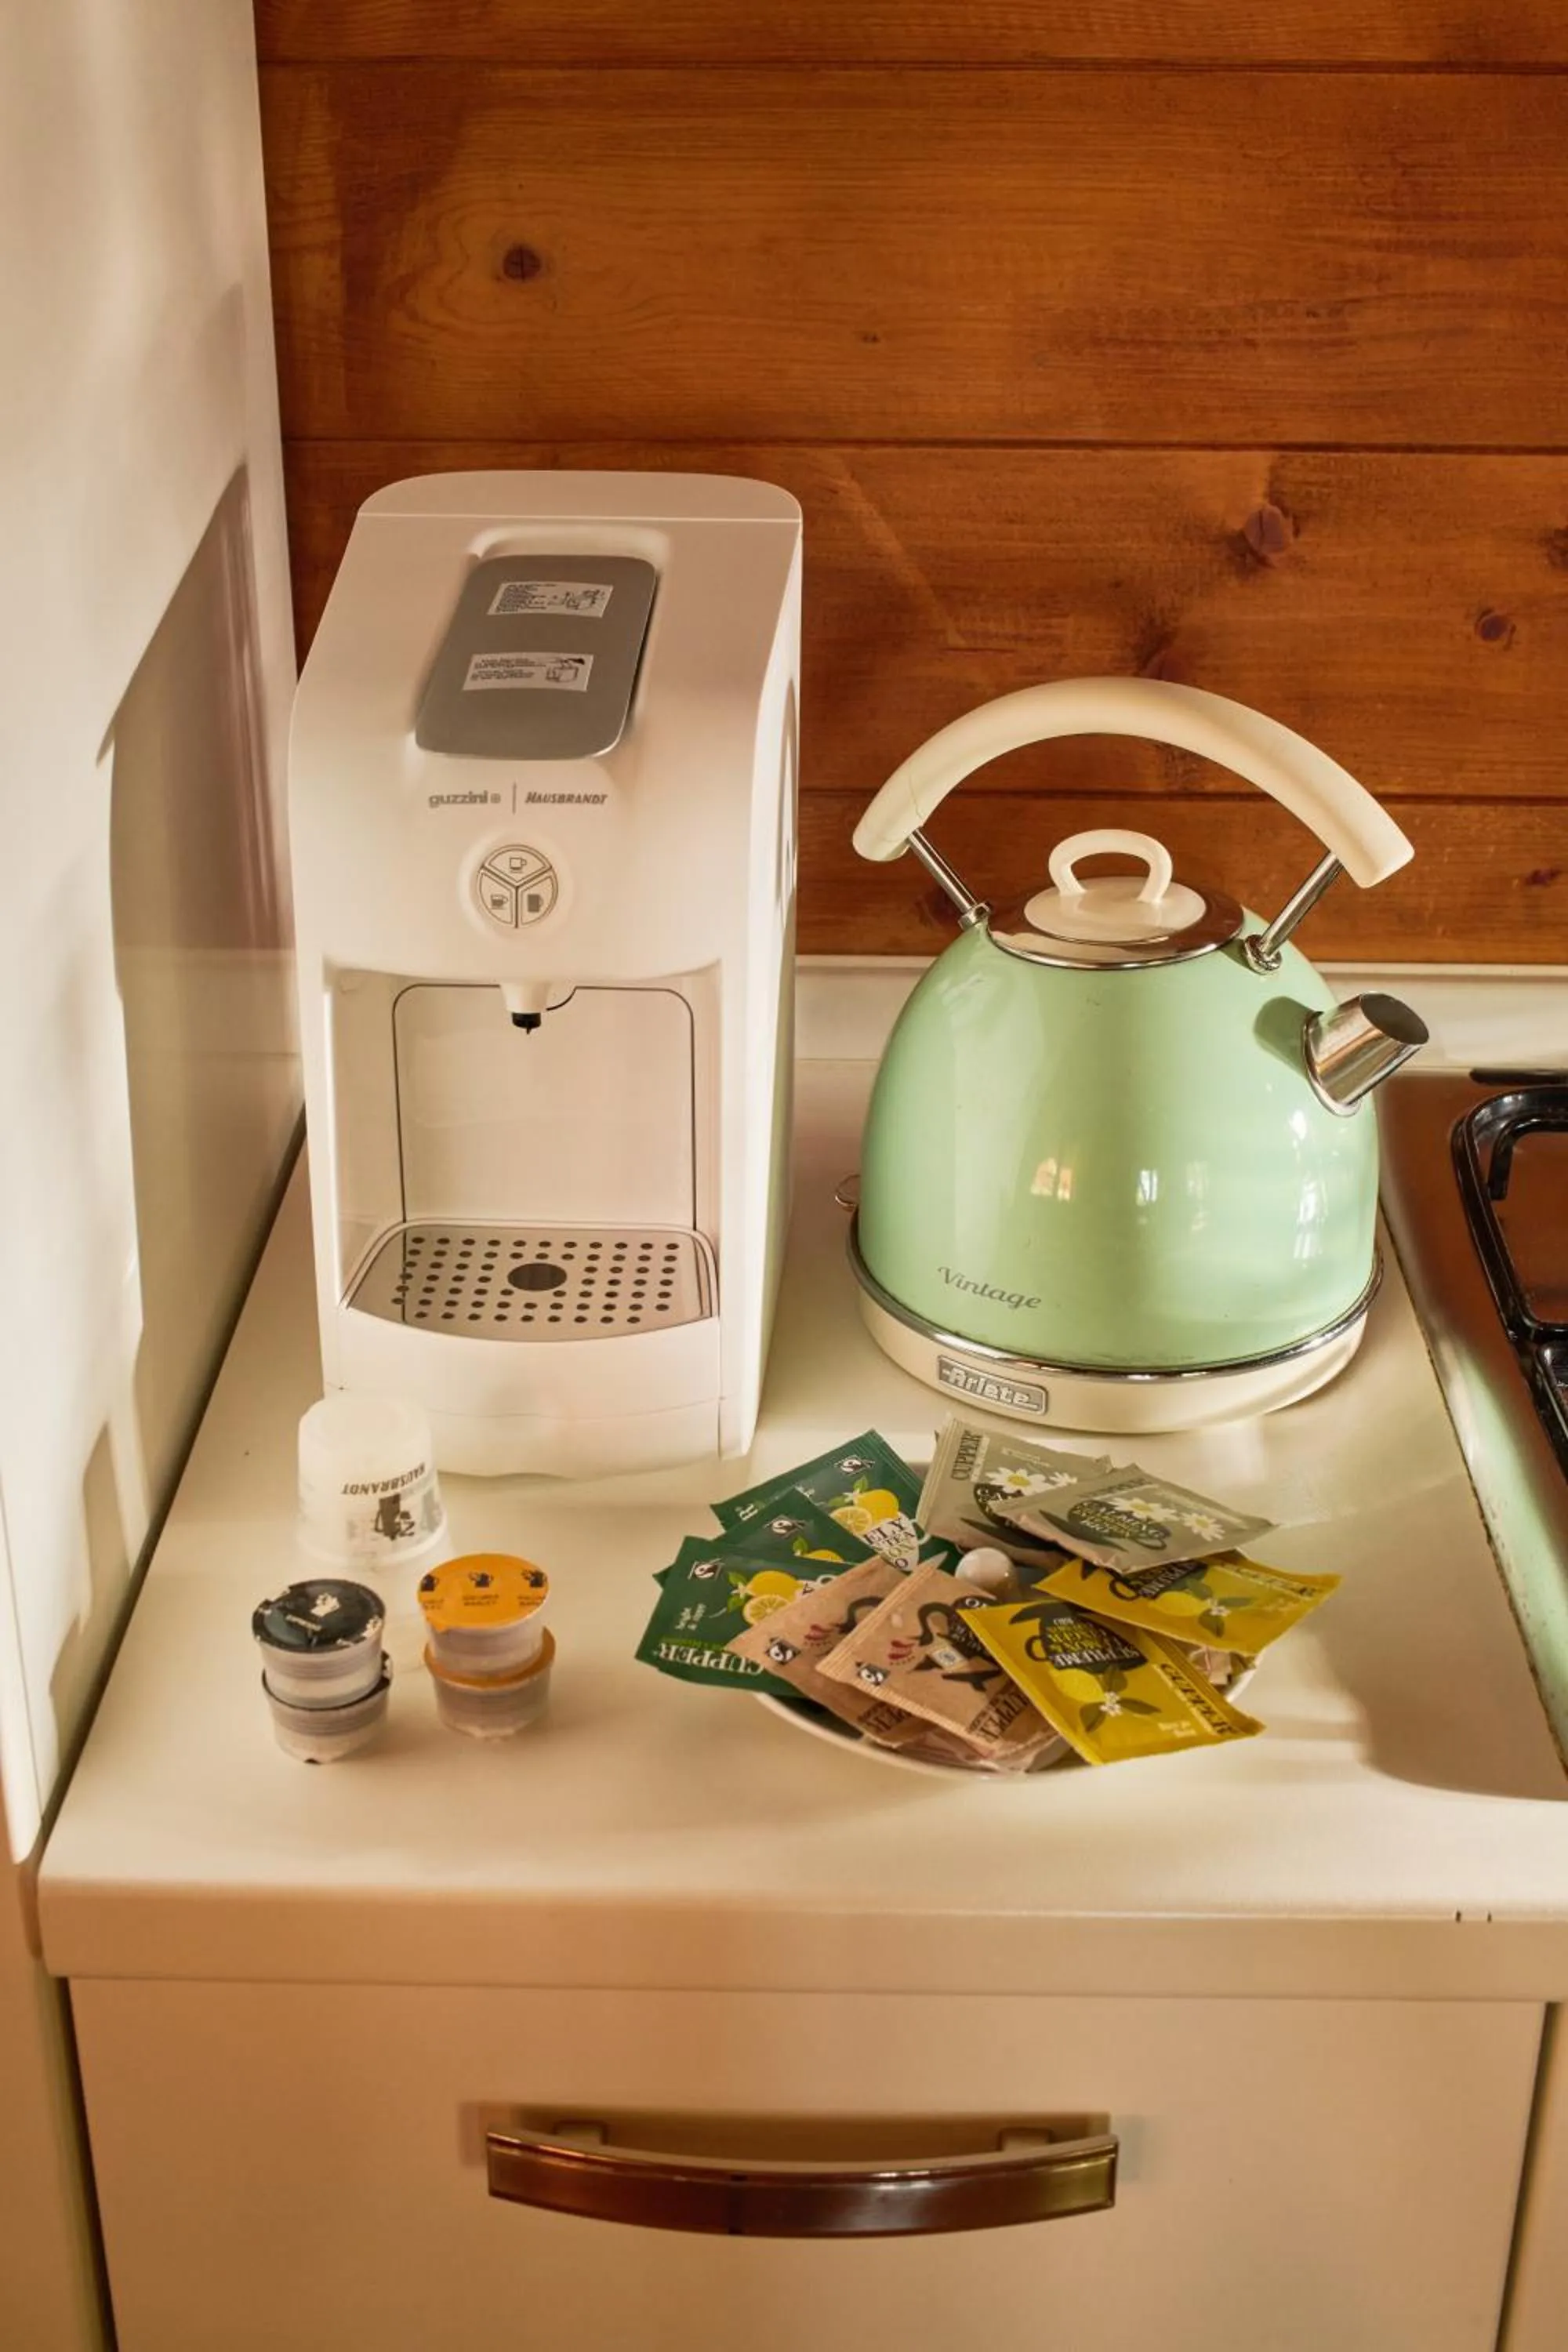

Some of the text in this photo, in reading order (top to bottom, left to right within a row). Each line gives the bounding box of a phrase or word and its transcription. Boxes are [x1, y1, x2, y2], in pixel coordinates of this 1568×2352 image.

[429, 790, 488, 808] guzzini
[938, 1266, 1042, 1309] Vintage
[943, 1367, 1039, 1409] Ariete
[951, 1431, 982, 1480] CUPPER
[864, 1517, 903, 1544] ELY
[659, 1642, 765, 1676] CUPPER
[978, 1691, 1031, 1744] UPPER
[1160, 1663, 1233, 1734] CUPPER
